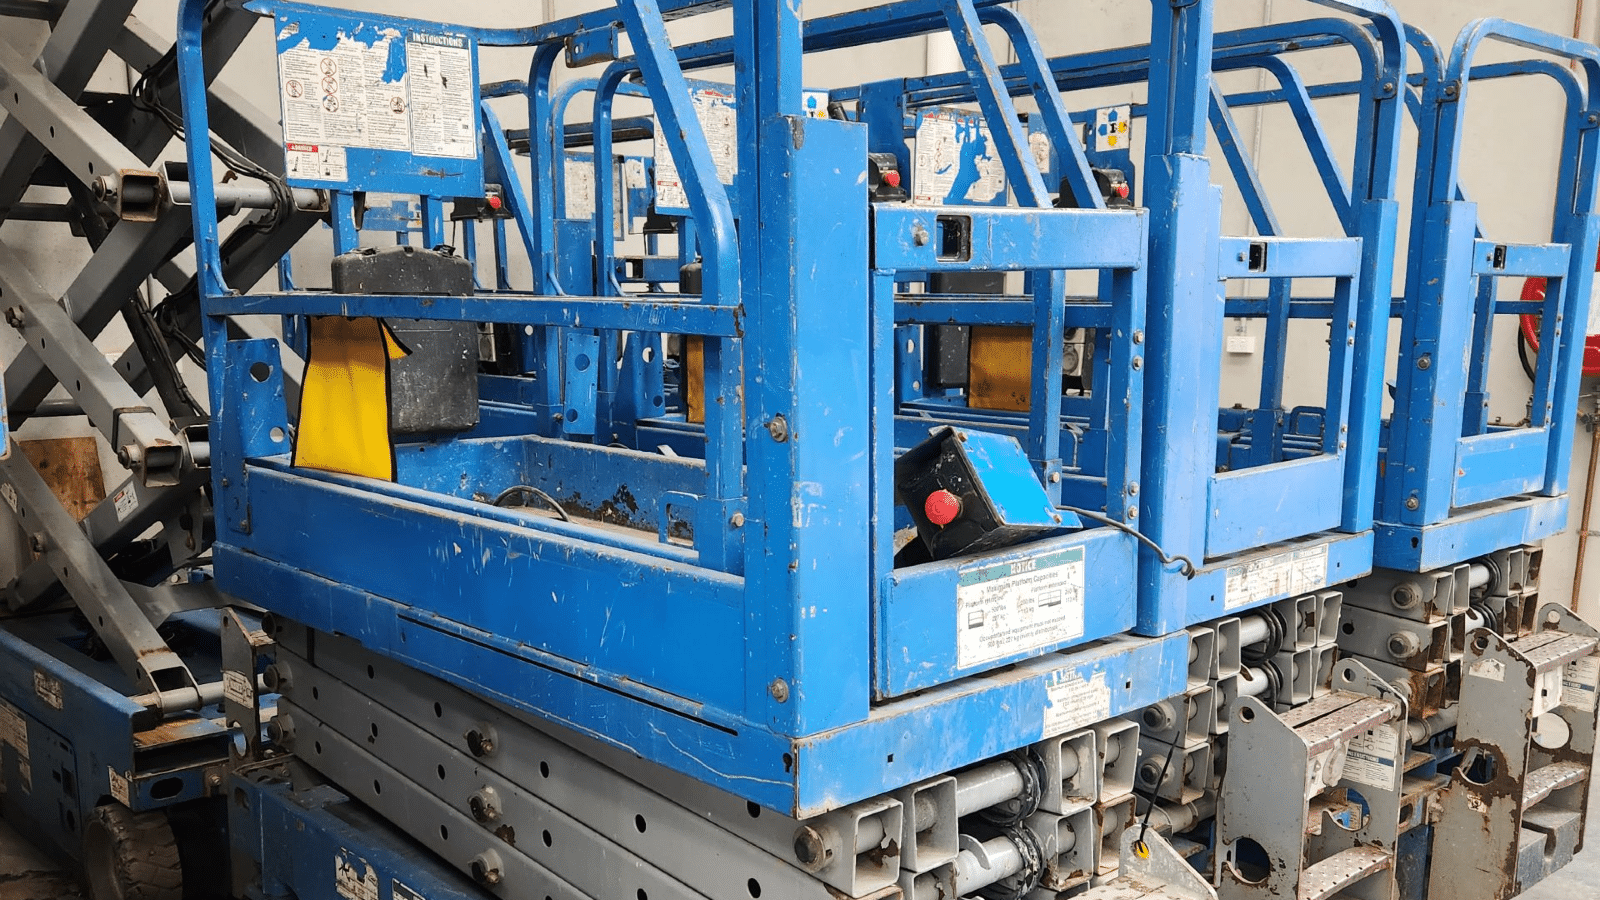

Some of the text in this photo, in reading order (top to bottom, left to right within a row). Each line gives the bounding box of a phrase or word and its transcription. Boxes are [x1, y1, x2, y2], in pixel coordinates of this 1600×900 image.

[412, 32, 463, 48] INSTRUCTIONS
[1010, 560, 1036, 574] NOTICE
[1012, 576, 1033, 588] Platform
[1034, 572, 1058, 582] Capacities
